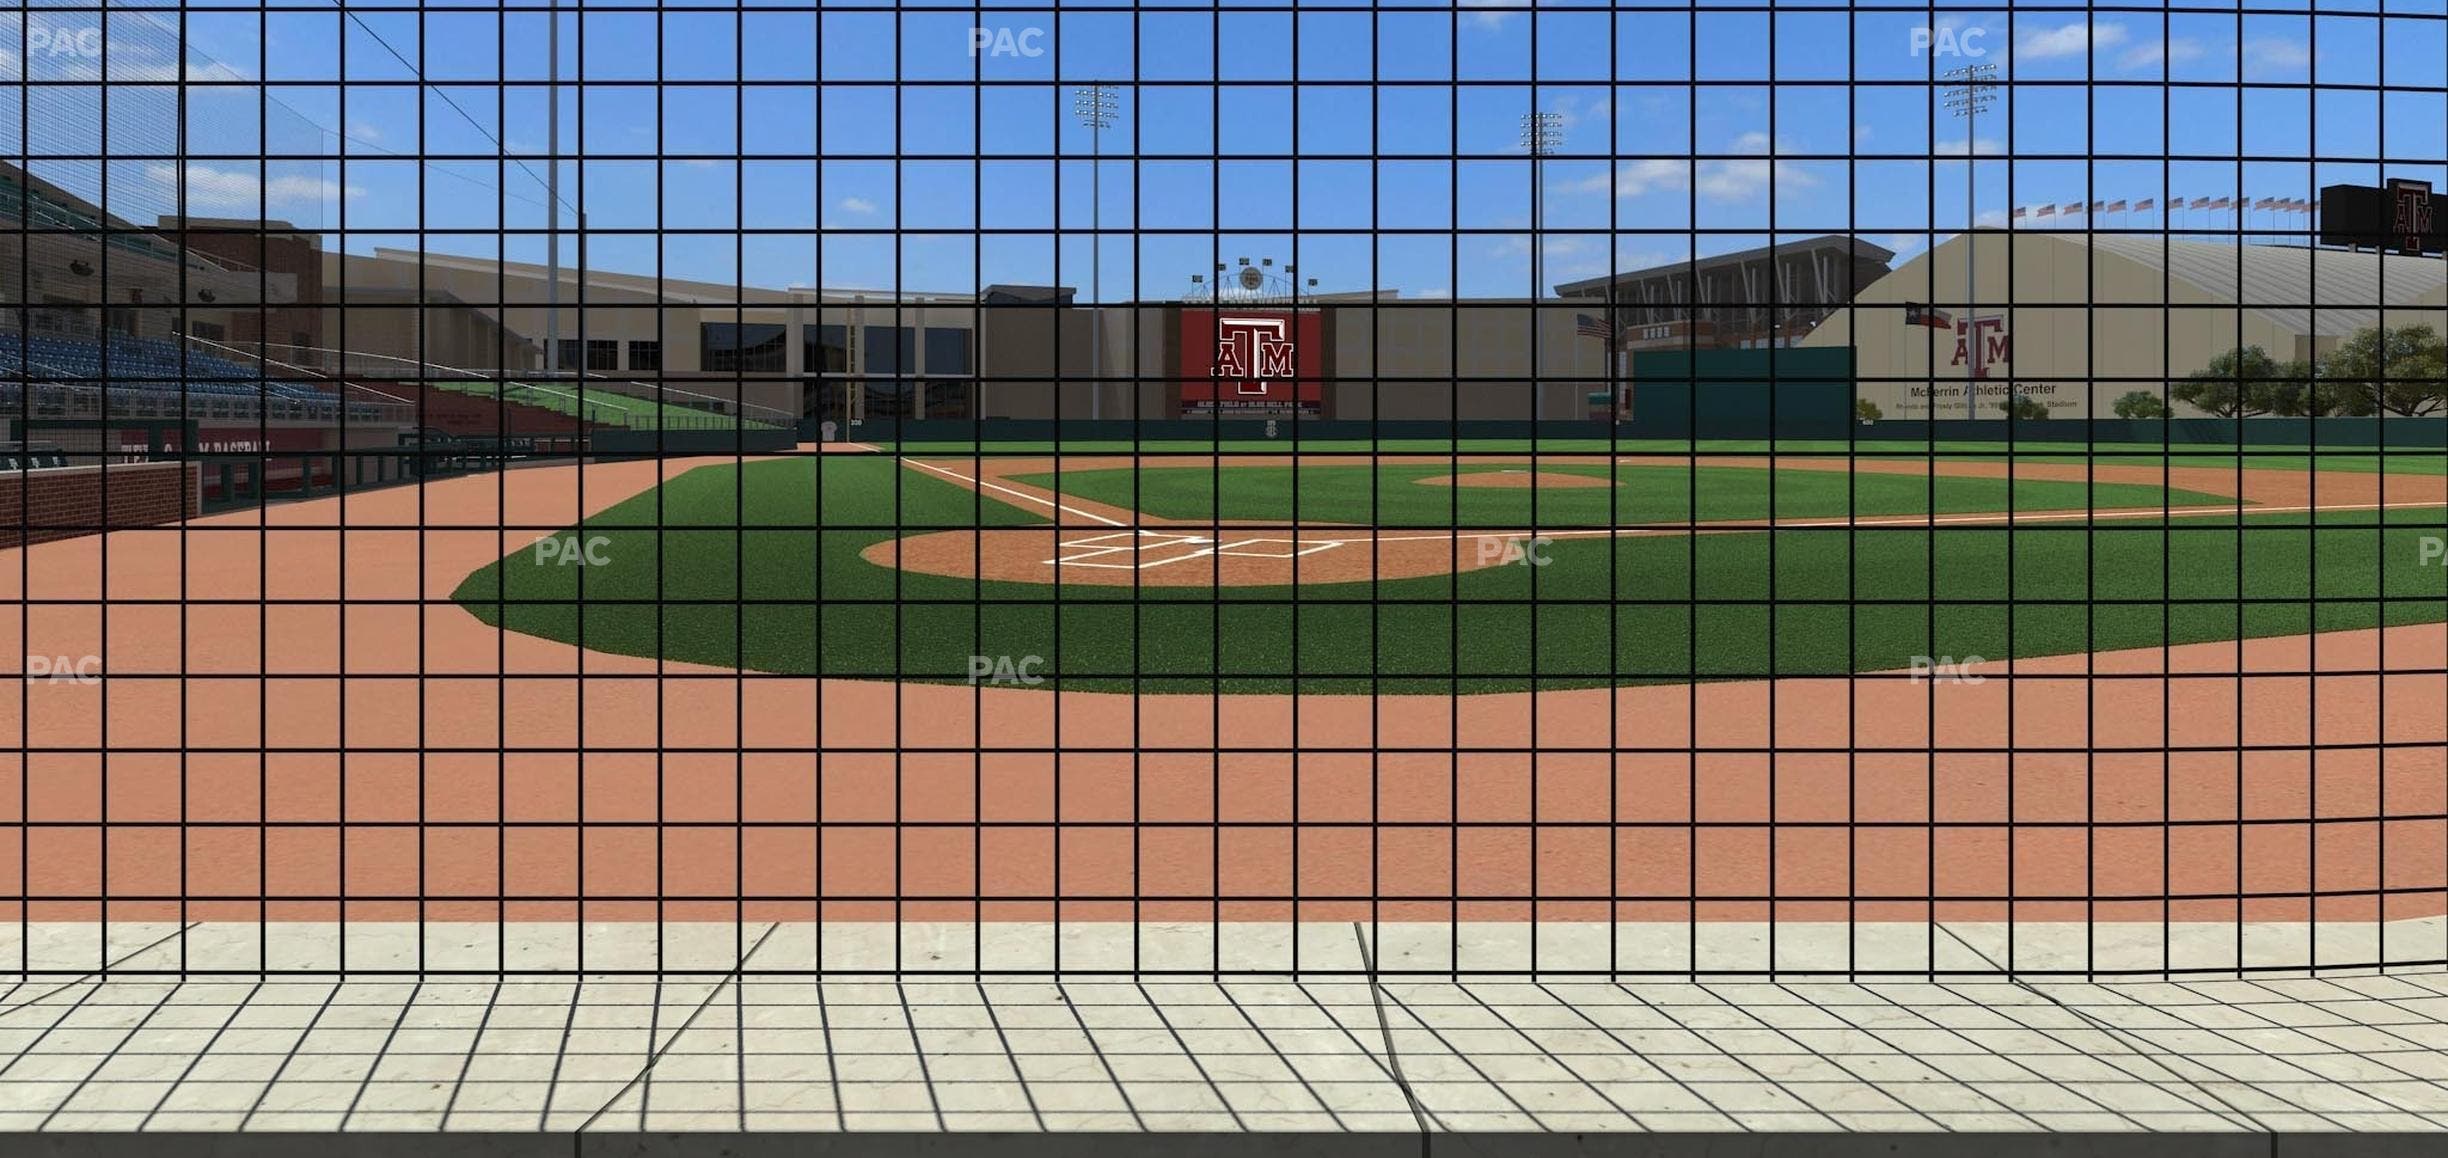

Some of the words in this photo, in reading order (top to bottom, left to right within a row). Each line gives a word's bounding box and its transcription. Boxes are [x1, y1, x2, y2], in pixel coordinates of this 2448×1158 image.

[1963, 384, 2009, 396] Ahletic
[2013, 383, 2057, 395] Center
[213, 440, 272, 459] BASEBAL
